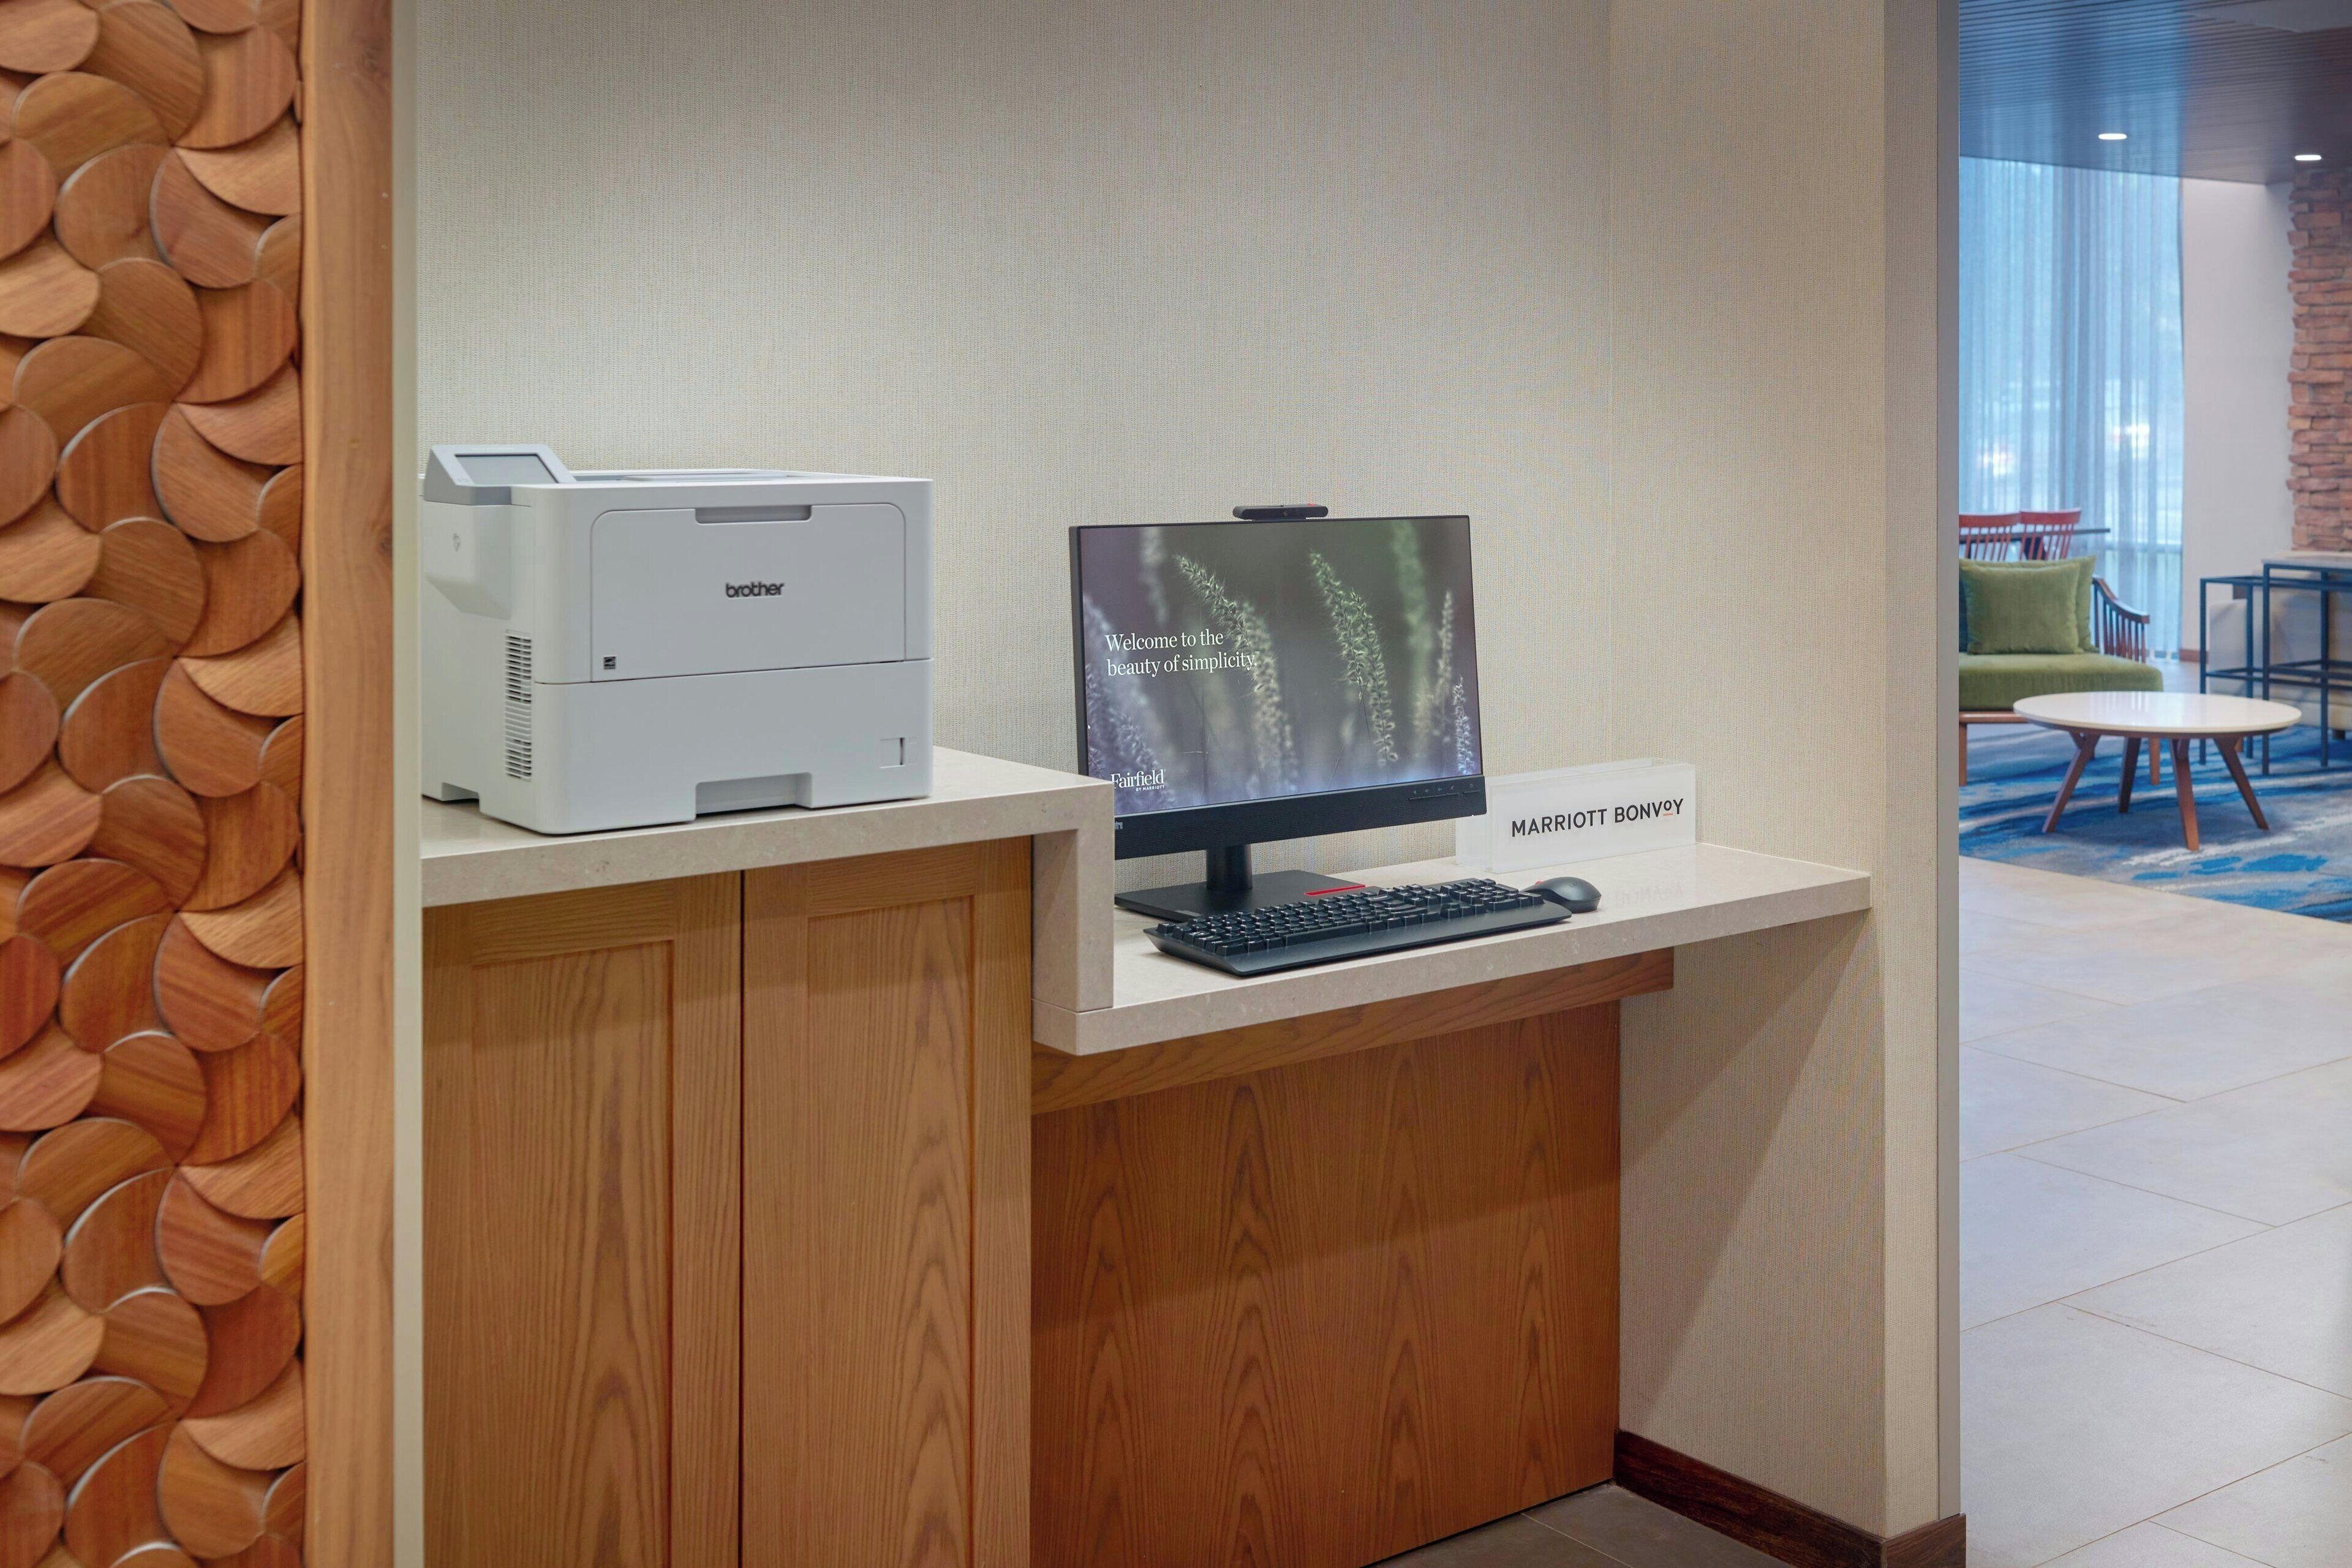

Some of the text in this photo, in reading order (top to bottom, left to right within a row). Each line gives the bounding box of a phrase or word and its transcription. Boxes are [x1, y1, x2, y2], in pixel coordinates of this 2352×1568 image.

[725, 581, 785, 598] brother
[1105, 628, 1224, 652] Welcome to the
[1107, 652, 1257, 677] beauty of simplicity.
[1110, 769, 1165, 789] Fairfield
[1512, 798, 1684, 837] MARRIOTT BONVOY
